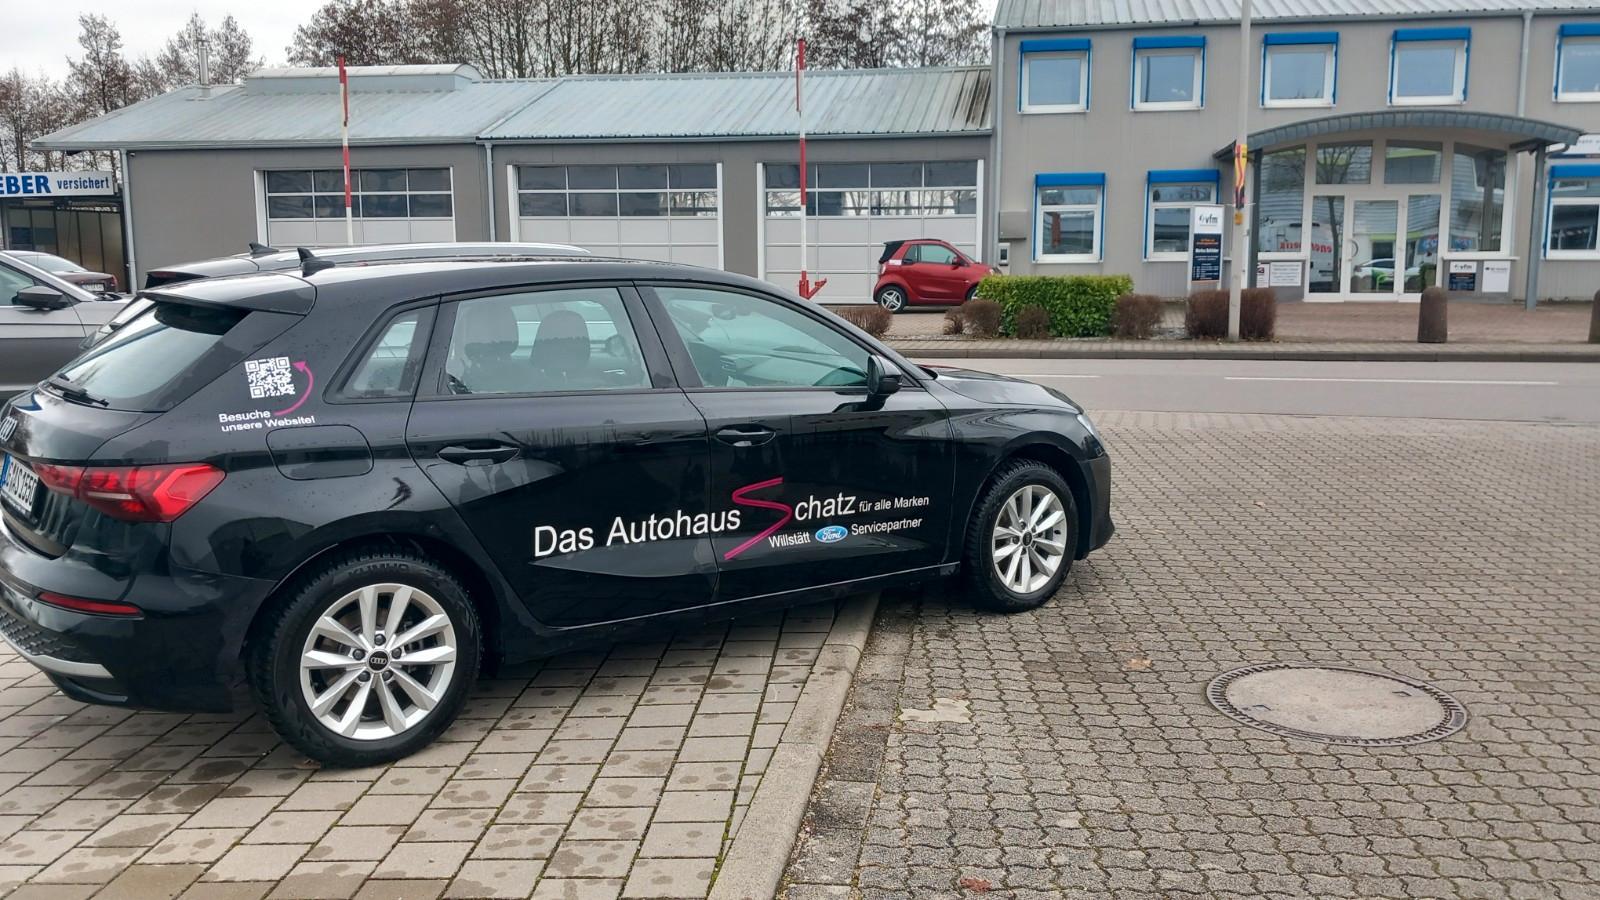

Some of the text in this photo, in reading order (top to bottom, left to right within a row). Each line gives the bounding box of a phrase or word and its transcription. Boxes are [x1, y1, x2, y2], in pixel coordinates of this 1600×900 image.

[57, 176, 110, 190] versichert
[1205, 213, 1218, 224] vfm
[219, 409, 271, 423] Besuche
[221, 421, 263, 432] unsere
[534, 476, 930, 560] Das Autohaus Schatz für alle Marken
[768, 531, 811, 548] Willstätt
[851, 516, 923, 536] Servicepartner
